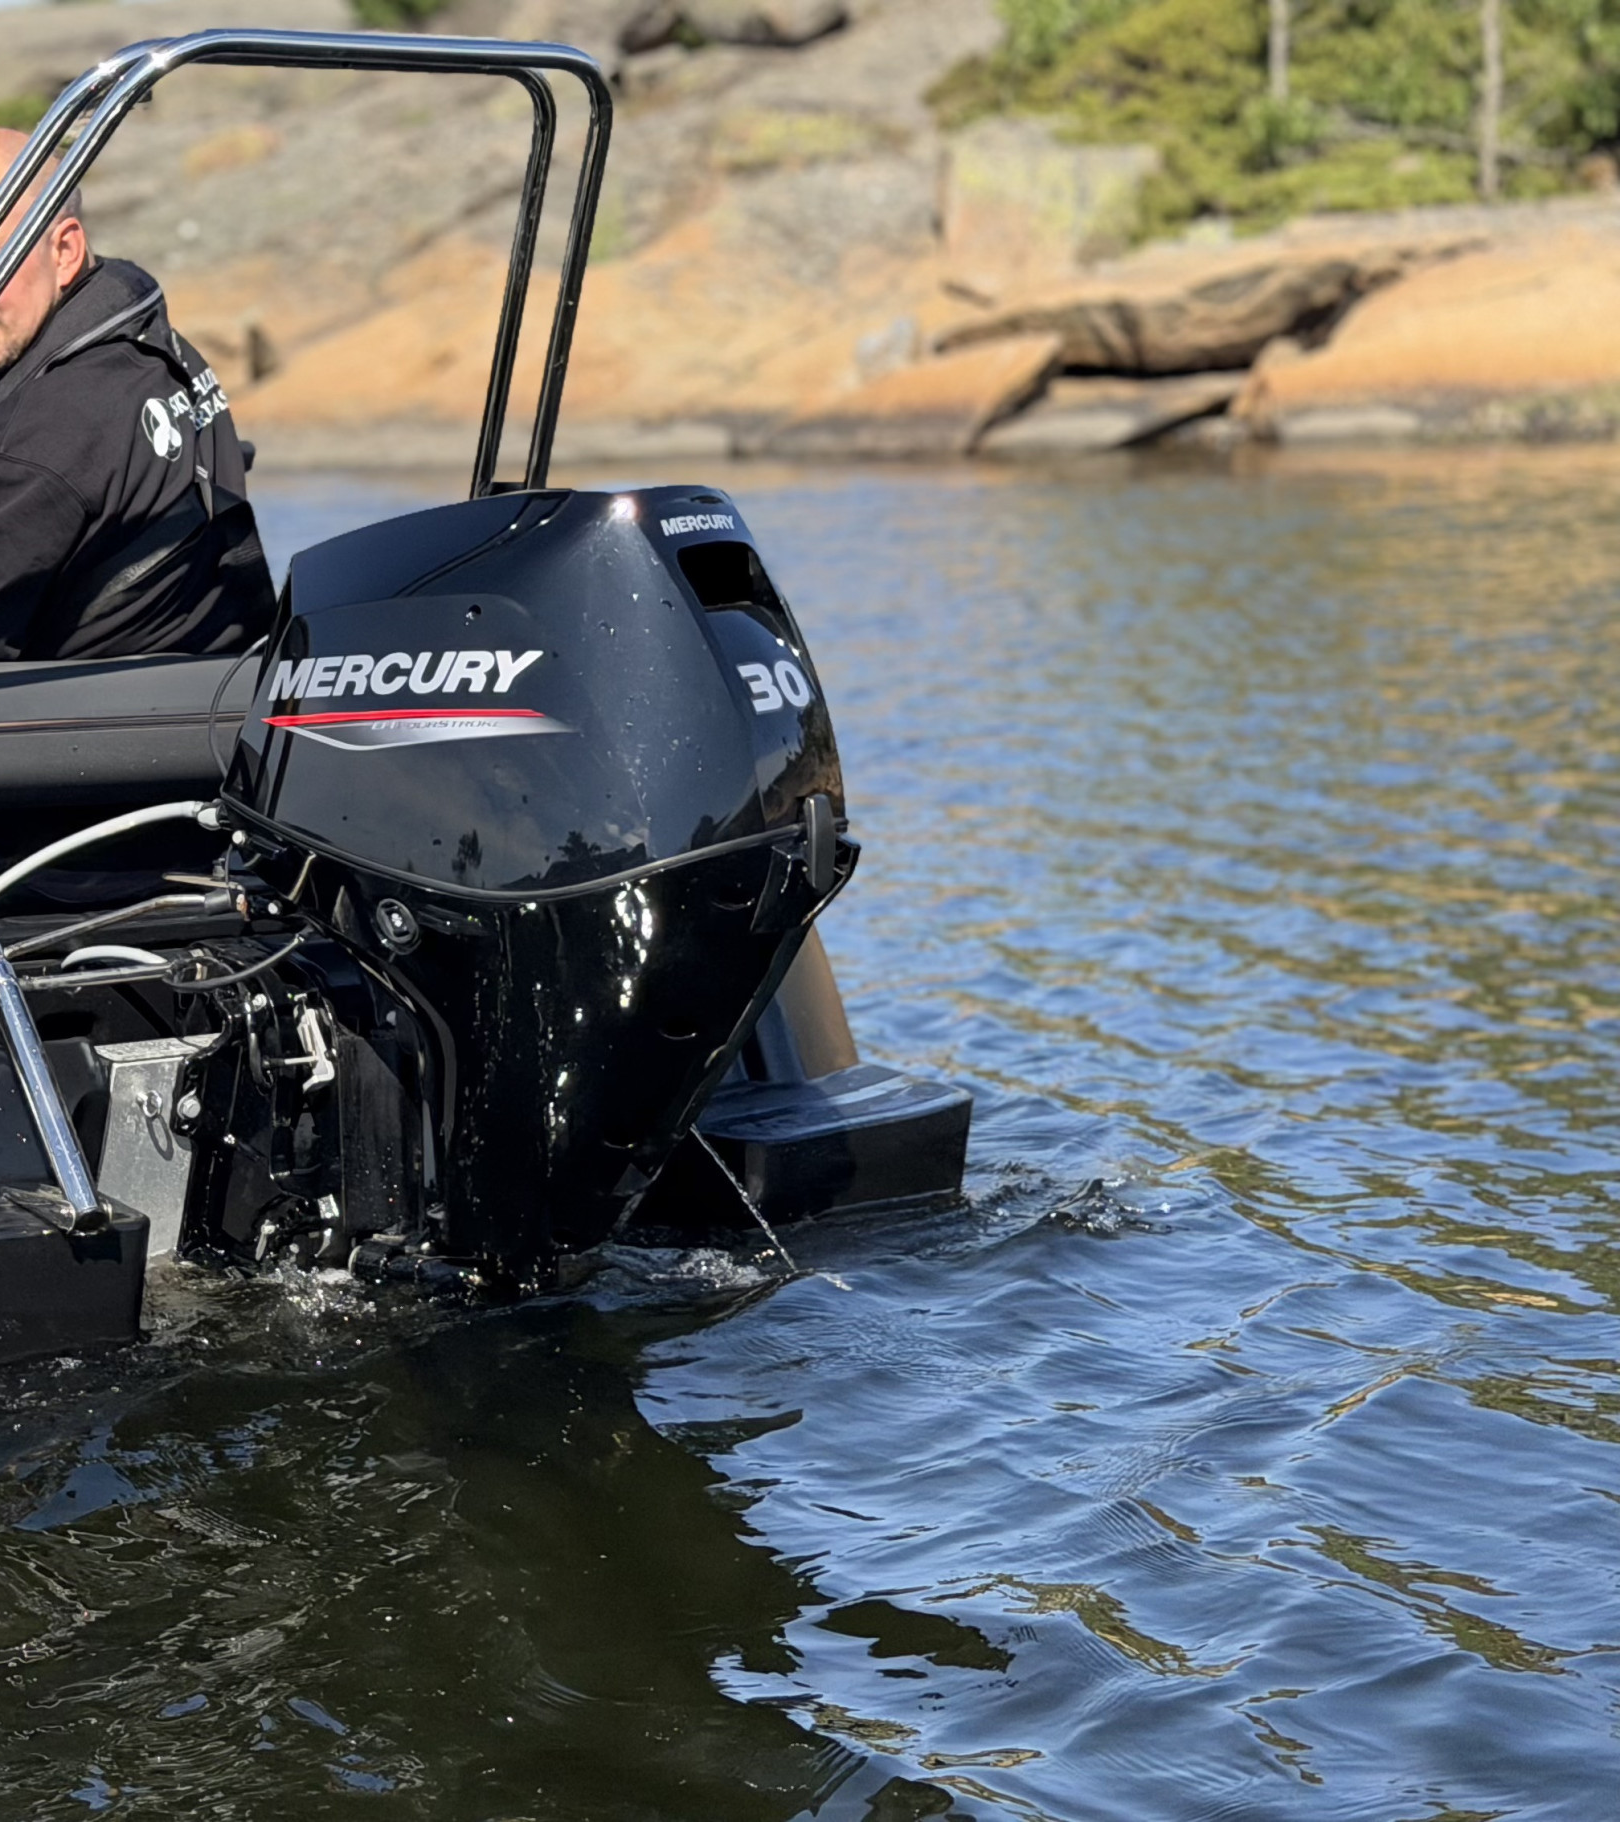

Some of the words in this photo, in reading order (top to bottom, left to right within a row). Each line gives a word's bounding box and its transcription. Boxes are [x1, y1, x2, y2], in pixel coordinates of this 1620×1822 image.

[660, 514, 736, 537] MERCURY
[268, 650, 545, 701] MERCURY
[737, 660, 811, 715] 30
